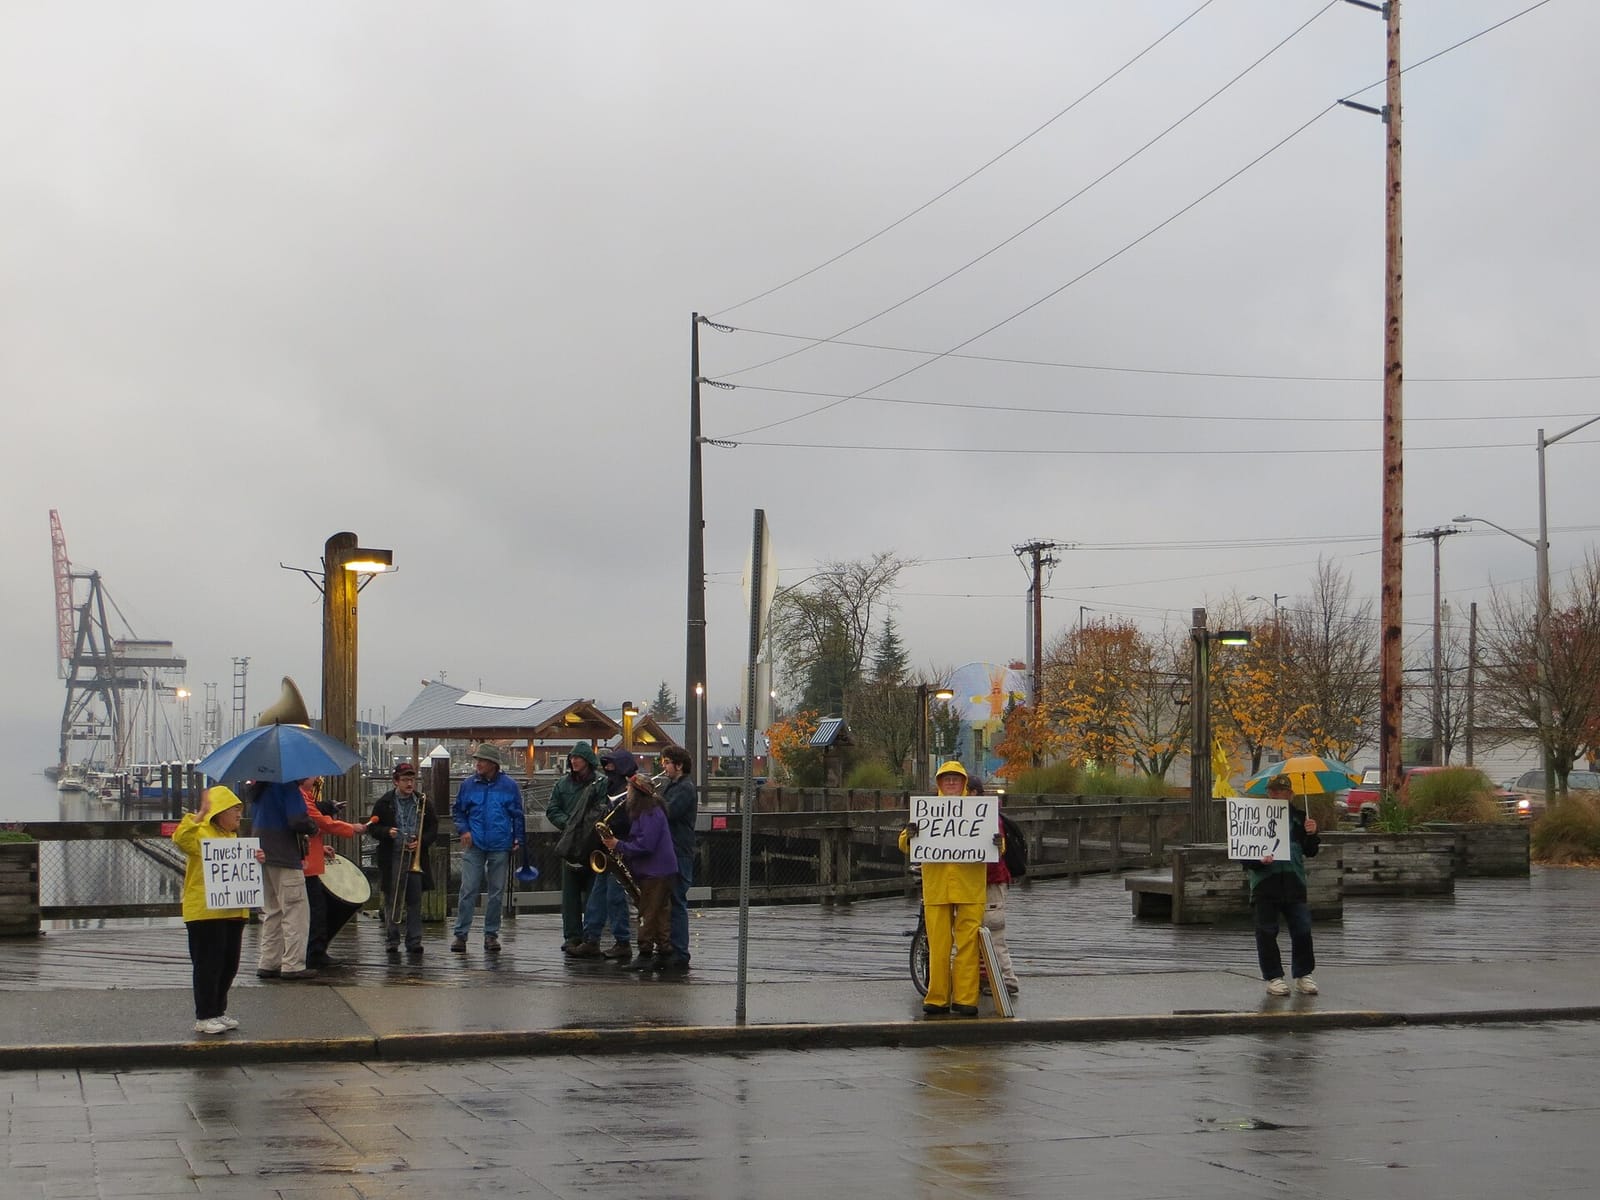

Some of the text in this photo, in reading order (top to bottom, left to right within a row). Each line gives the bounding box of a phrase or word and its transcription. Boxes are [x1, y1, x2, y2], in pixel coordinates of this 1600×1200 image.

[916, 799, 988, 818] Build a
[1228, 801, 1287, 824] Bring our
[916, 818, 984, 837] PEACE
[1230, 819, 1278, 838] Billion$
[203, 841, 256, 861] Invest in
[914, 845, 986, 863] economy
[1231, 838, 1280, 857] Home!
[211, 862, 260, 884] PEACE,
[210, 885, 260, 907] not war
